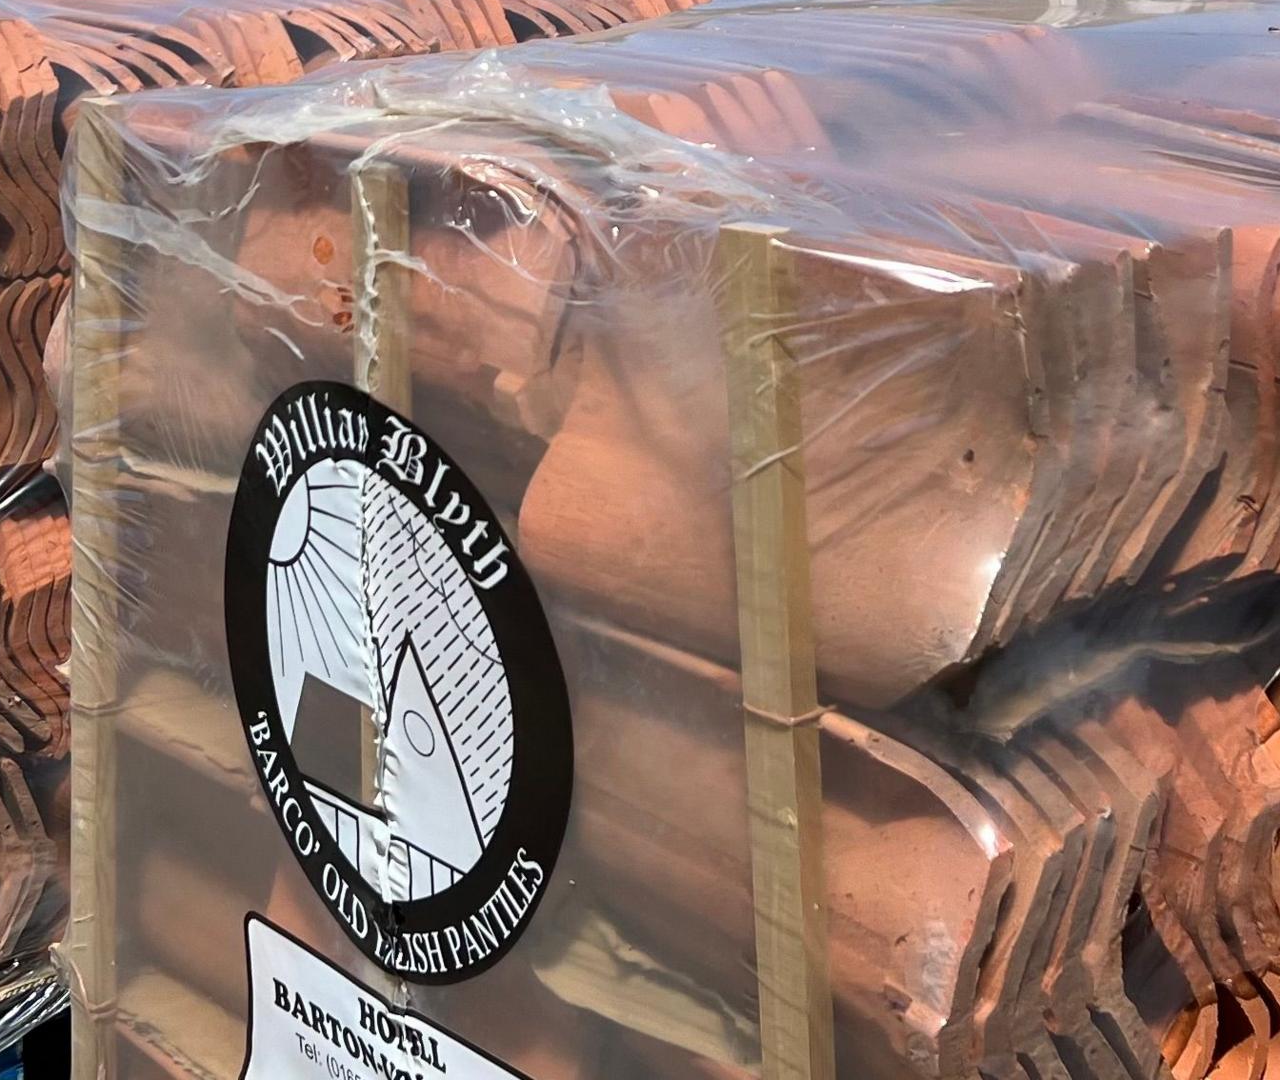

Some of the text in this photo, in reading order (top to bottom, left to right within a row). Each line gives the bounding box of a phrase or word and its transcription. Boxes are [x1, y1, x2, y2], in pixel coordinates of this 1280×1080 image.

[376, 415, 510, 590] Blyth
[249, 710, 320, 856] 'BARCO'
[323, 863, 368, 939] OLD
[443, 847, 544, 970] PANTILES
[295, 1032, 322, 1066] Tel:
